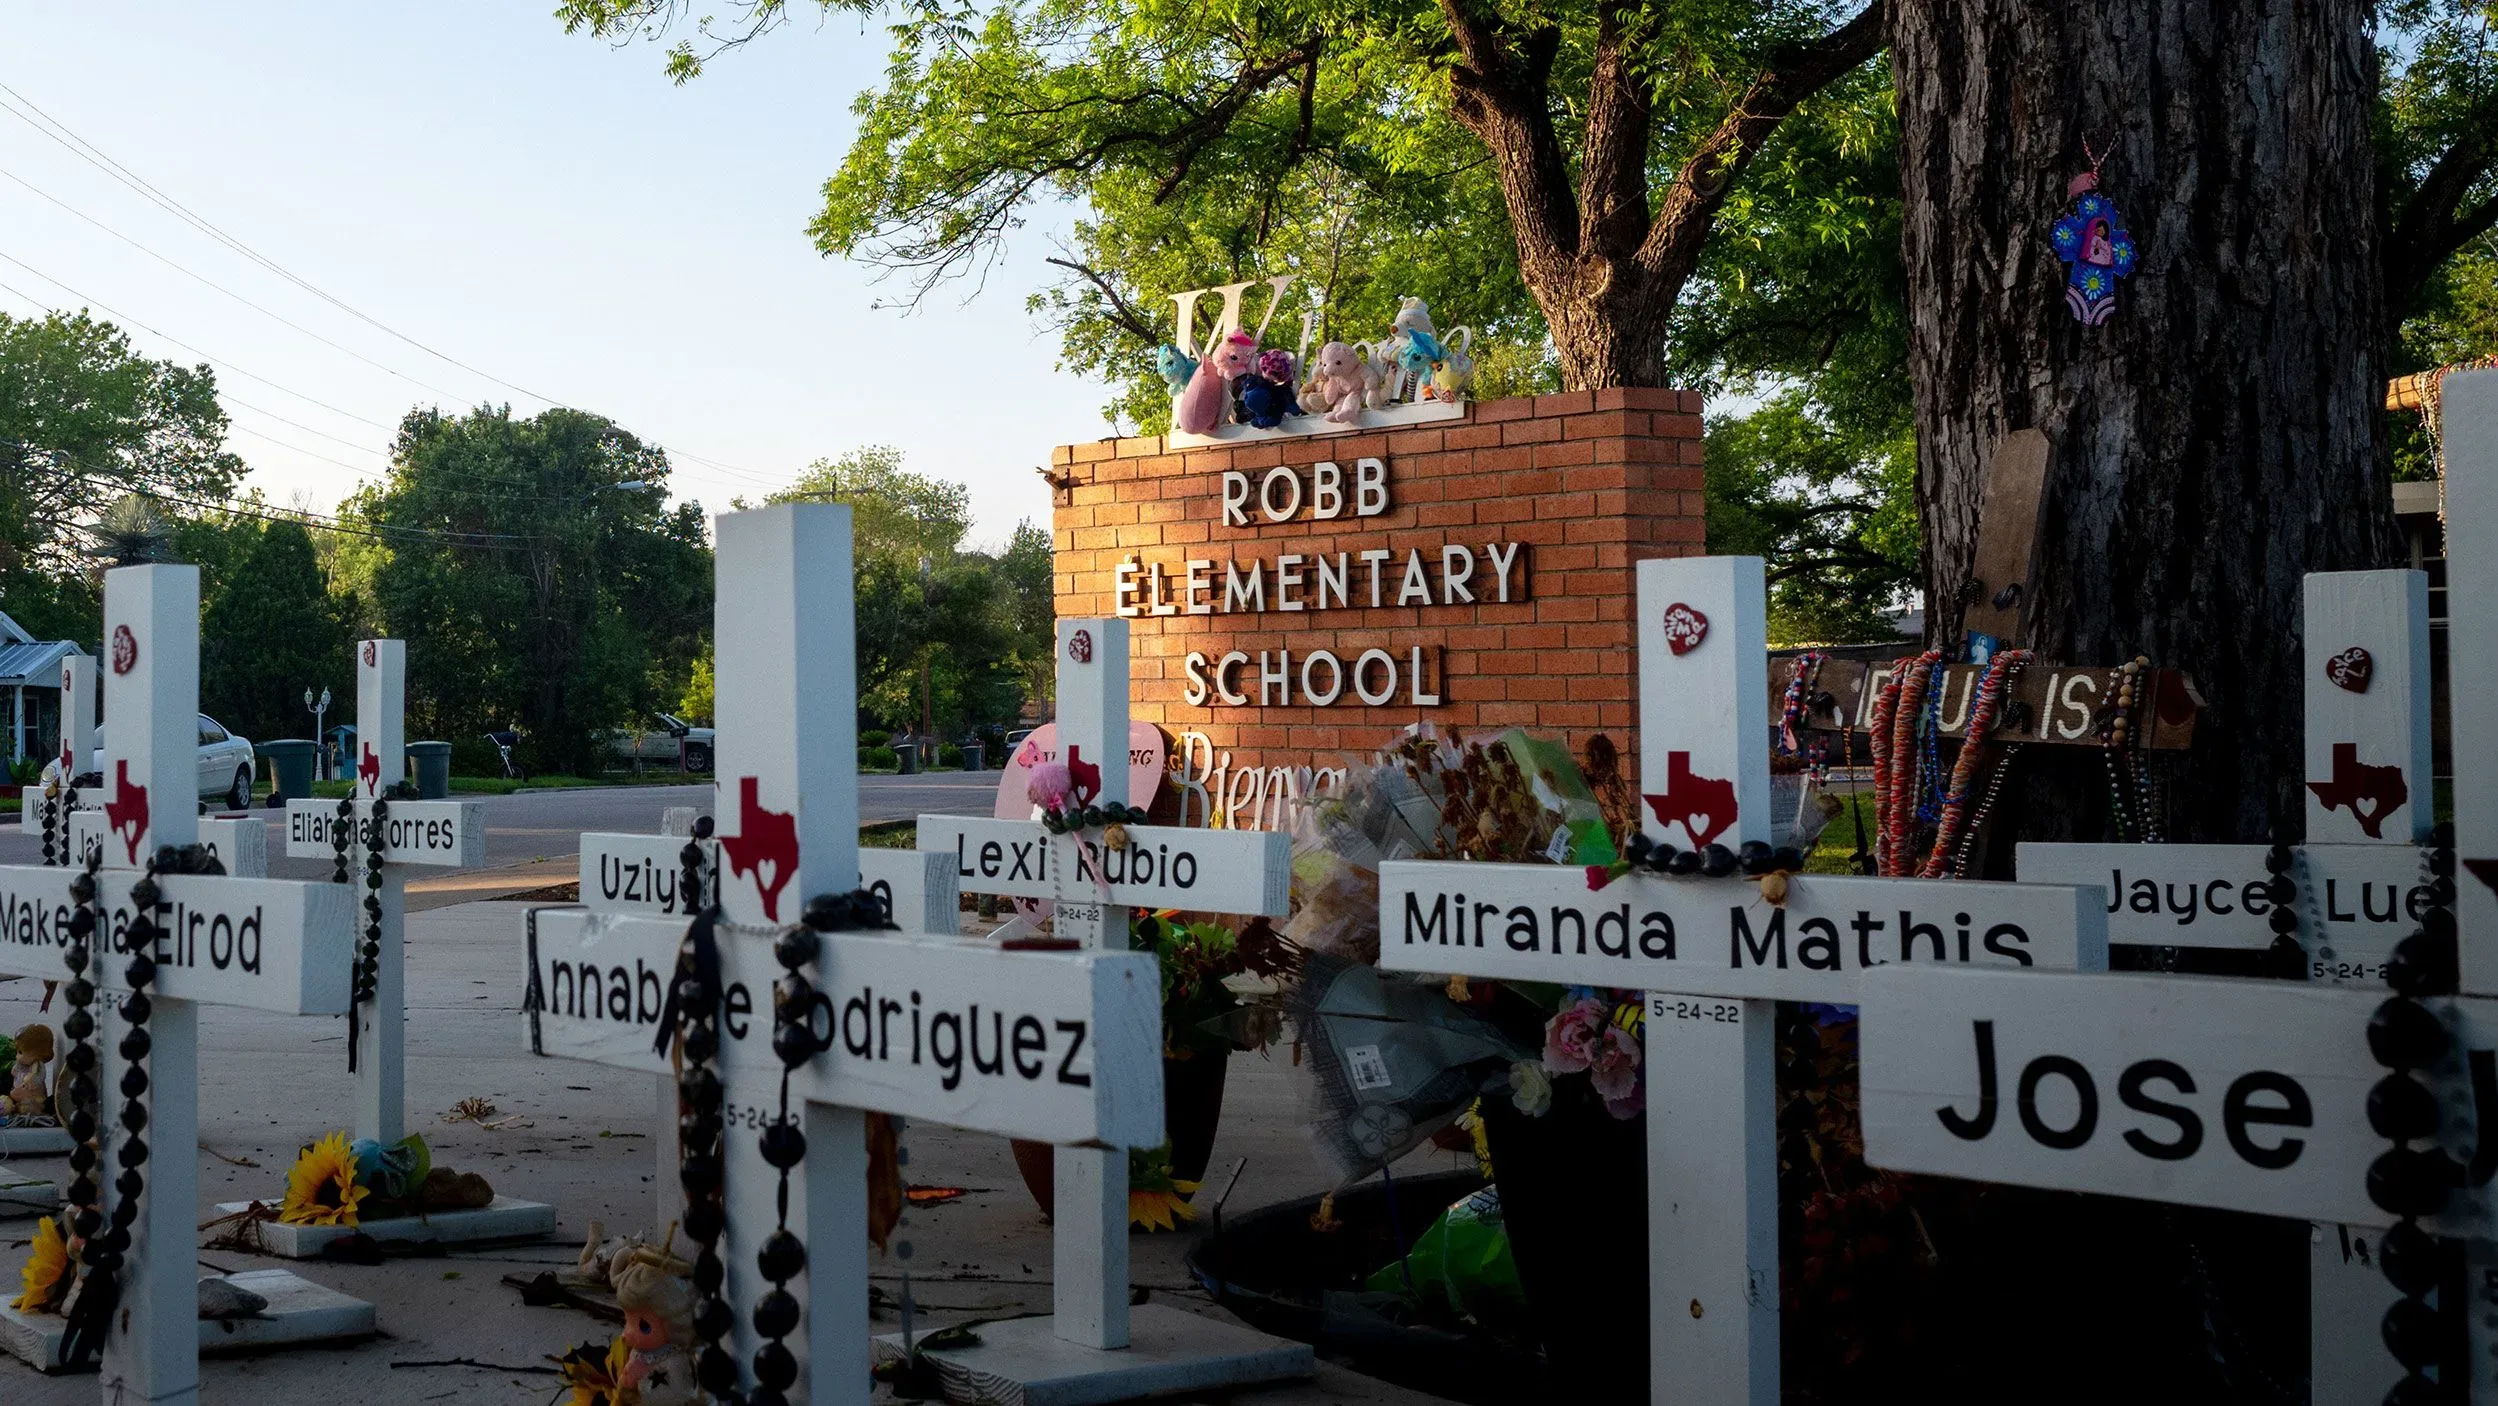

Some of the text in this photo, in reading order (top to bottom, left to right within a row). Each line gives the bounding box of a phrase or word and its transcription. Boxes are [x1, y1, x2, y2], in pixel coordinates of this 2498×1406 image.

[1222, 457, 1389, 527] ROBB
[1115, 542, 1519, 617] ELEMENTARY
[1184, 645, 1440, 707] SCHOOL
[2040, 672, 2097, 741] IS
[376, 817, 454, 850] orres
[957, 833, 1197, 889] Lexi Rubio
[2107, 868, 2271, 926] Jayce
[0, 890, 262, 975] Makena Elrod
[1404, 891, 2034, 971] Miranda Mathis
[2313, 963, 2389, 980] 5-24-2
[773, 980, 1092, 1092] odriguez
[1653, 1000, 1739, 1024] 5-24-22
[727, 1103, 800, 1131] 5-24-2
[1935, 1019, 2315, 1171] Jose
